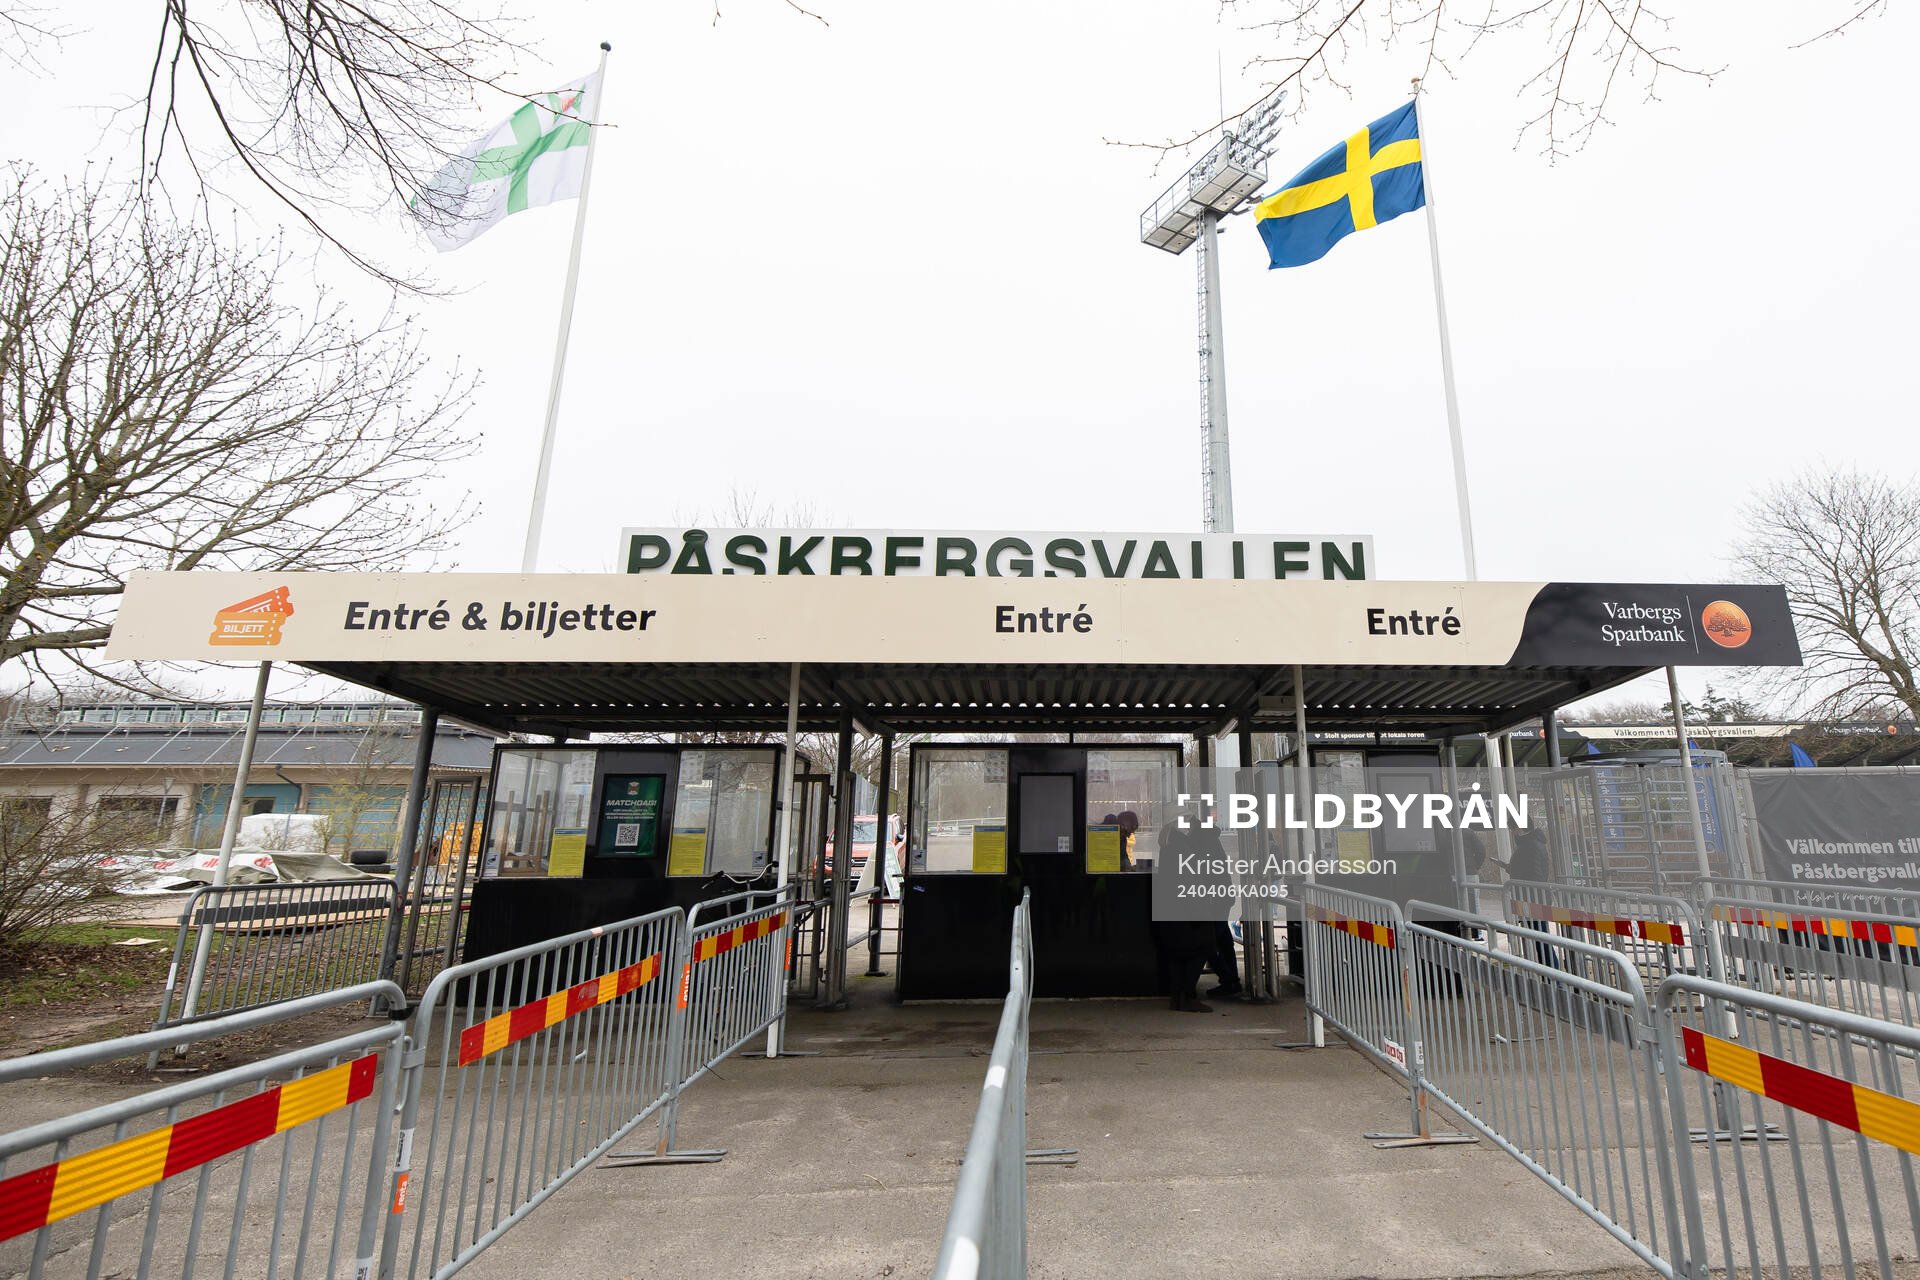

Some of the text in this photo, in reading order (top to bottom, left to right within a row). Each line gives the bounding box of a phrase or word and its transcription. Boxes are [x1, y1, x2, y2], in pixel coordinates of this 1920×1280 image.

[344, 600, 656, 638] Entré & biljetter
[995, 603, 1093, 633] Entré
[1367, 606, 1461, 636] Entré
[1603, 602, 1682, 624] Varbergs
[223, 624, 264, 633] BILJETT
[1601, 625, 1686, 646] Sparbank
[1614, 729, 1665, 737] Välkommen
[1785, 838, 1920, 854] Välkommen till
[1791, 862, 1920, 883] Påskbergsvall
[398, 1180, 408, 1206] renta
